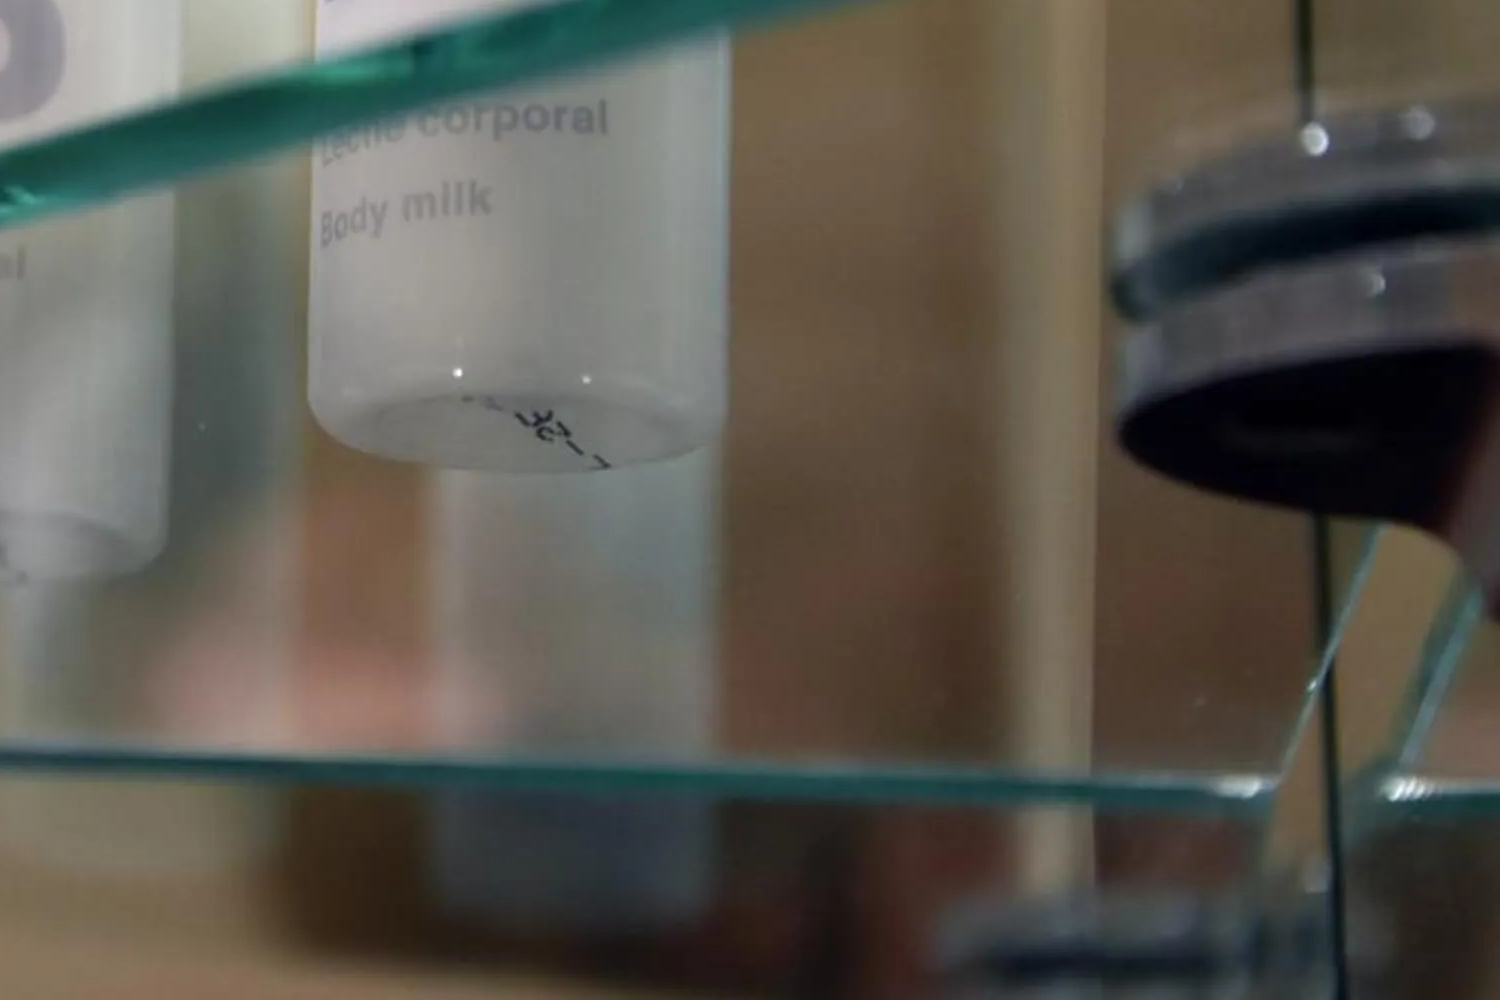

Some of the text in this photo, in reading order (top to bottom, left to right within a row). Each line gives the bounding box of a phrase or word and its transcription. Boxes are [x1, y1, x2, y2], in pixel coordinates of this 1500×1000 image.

[416, 97, 609, 142] corporal
[320, 177, 495, 249] Body milk
